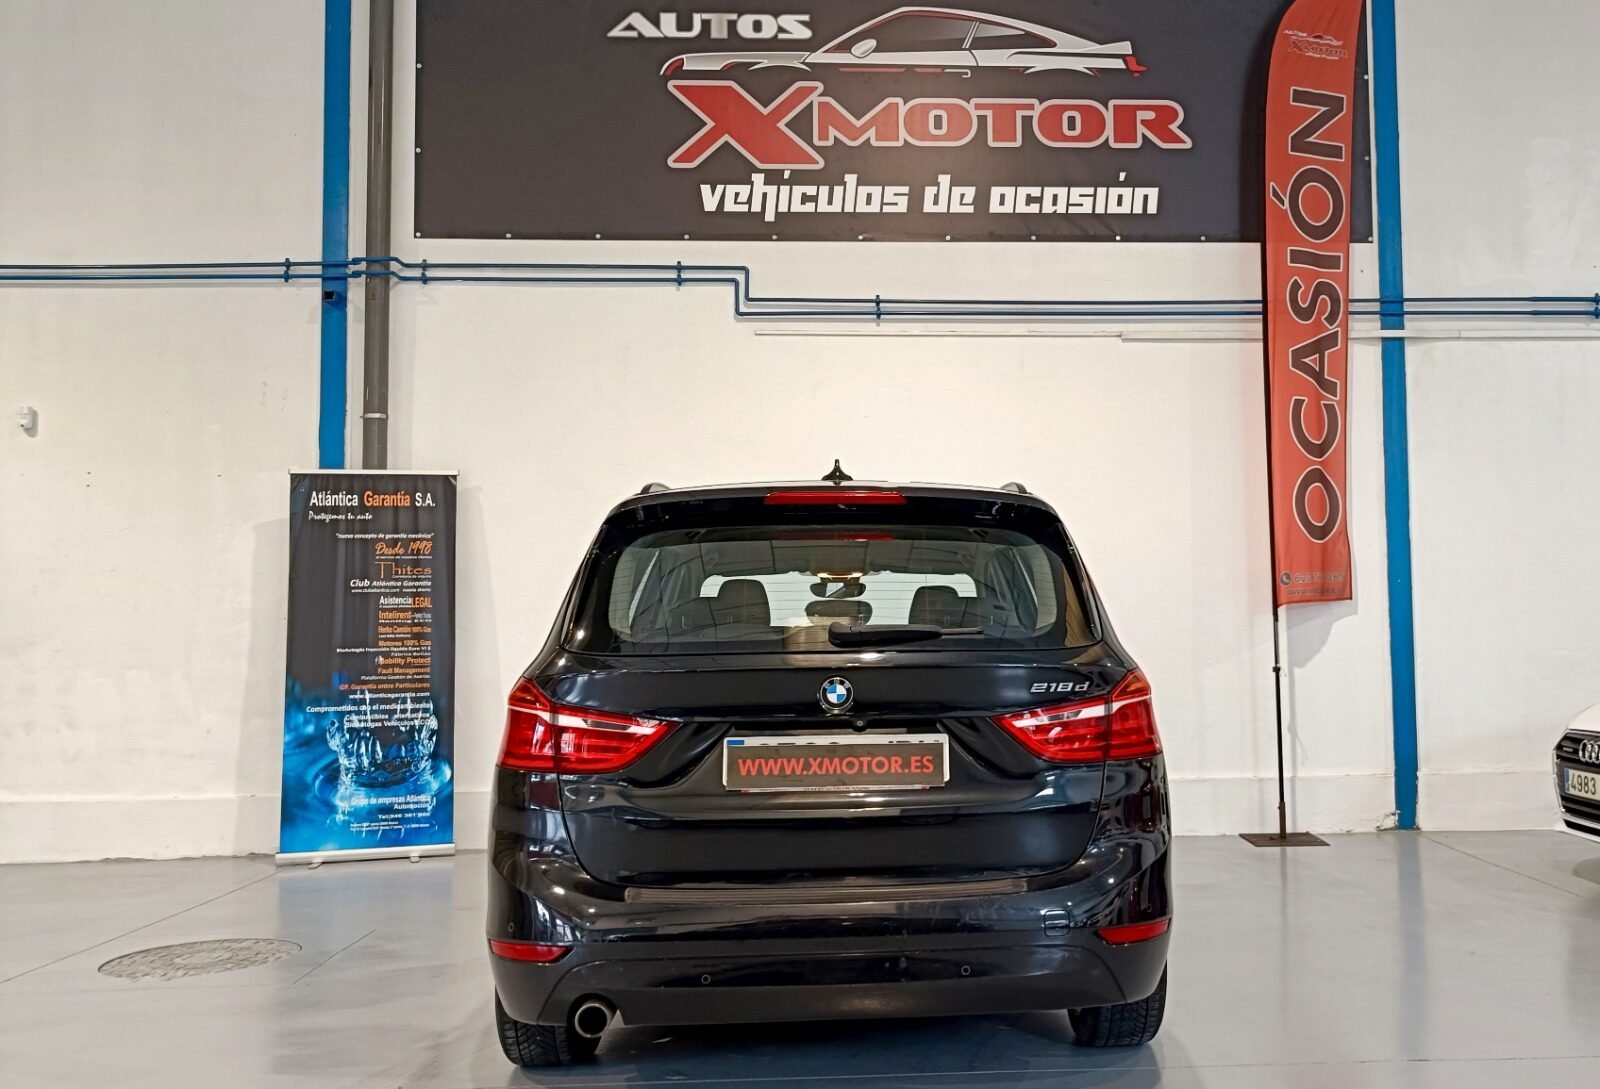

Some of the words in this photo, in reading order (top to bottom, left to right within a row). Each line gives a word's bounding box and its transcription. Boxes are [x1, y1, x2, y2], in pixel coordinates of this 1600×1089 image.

[607, 12, 812, 39] AUTOS
[667, 79, 1193, 169] XMOTOR
[923, 174, 976, 214] de
[989, 171, 1159, 214] ocasión
[1269, 86, 1347, 543] OCASIÓN
[309, 490, 359, 507] Atlántica
[363, 490, 411, 507] Garantía
[415, 492, 436, 507] S.A.
[308, 511, 346, 523] Protegemos
[347, 512, 355, 520] tu
[375, 541, 406, 556] Desde
[408, 540, 433, 555] 1998
[350, 579, 370, 587] Club
[406, 656, 432, 665] Protect
[306, 704, 358, 713] Comprometidos
[737, 755, 935, 776] WWW.XMOTOR.ES
[1570, 773, 1597, 796] 4983
